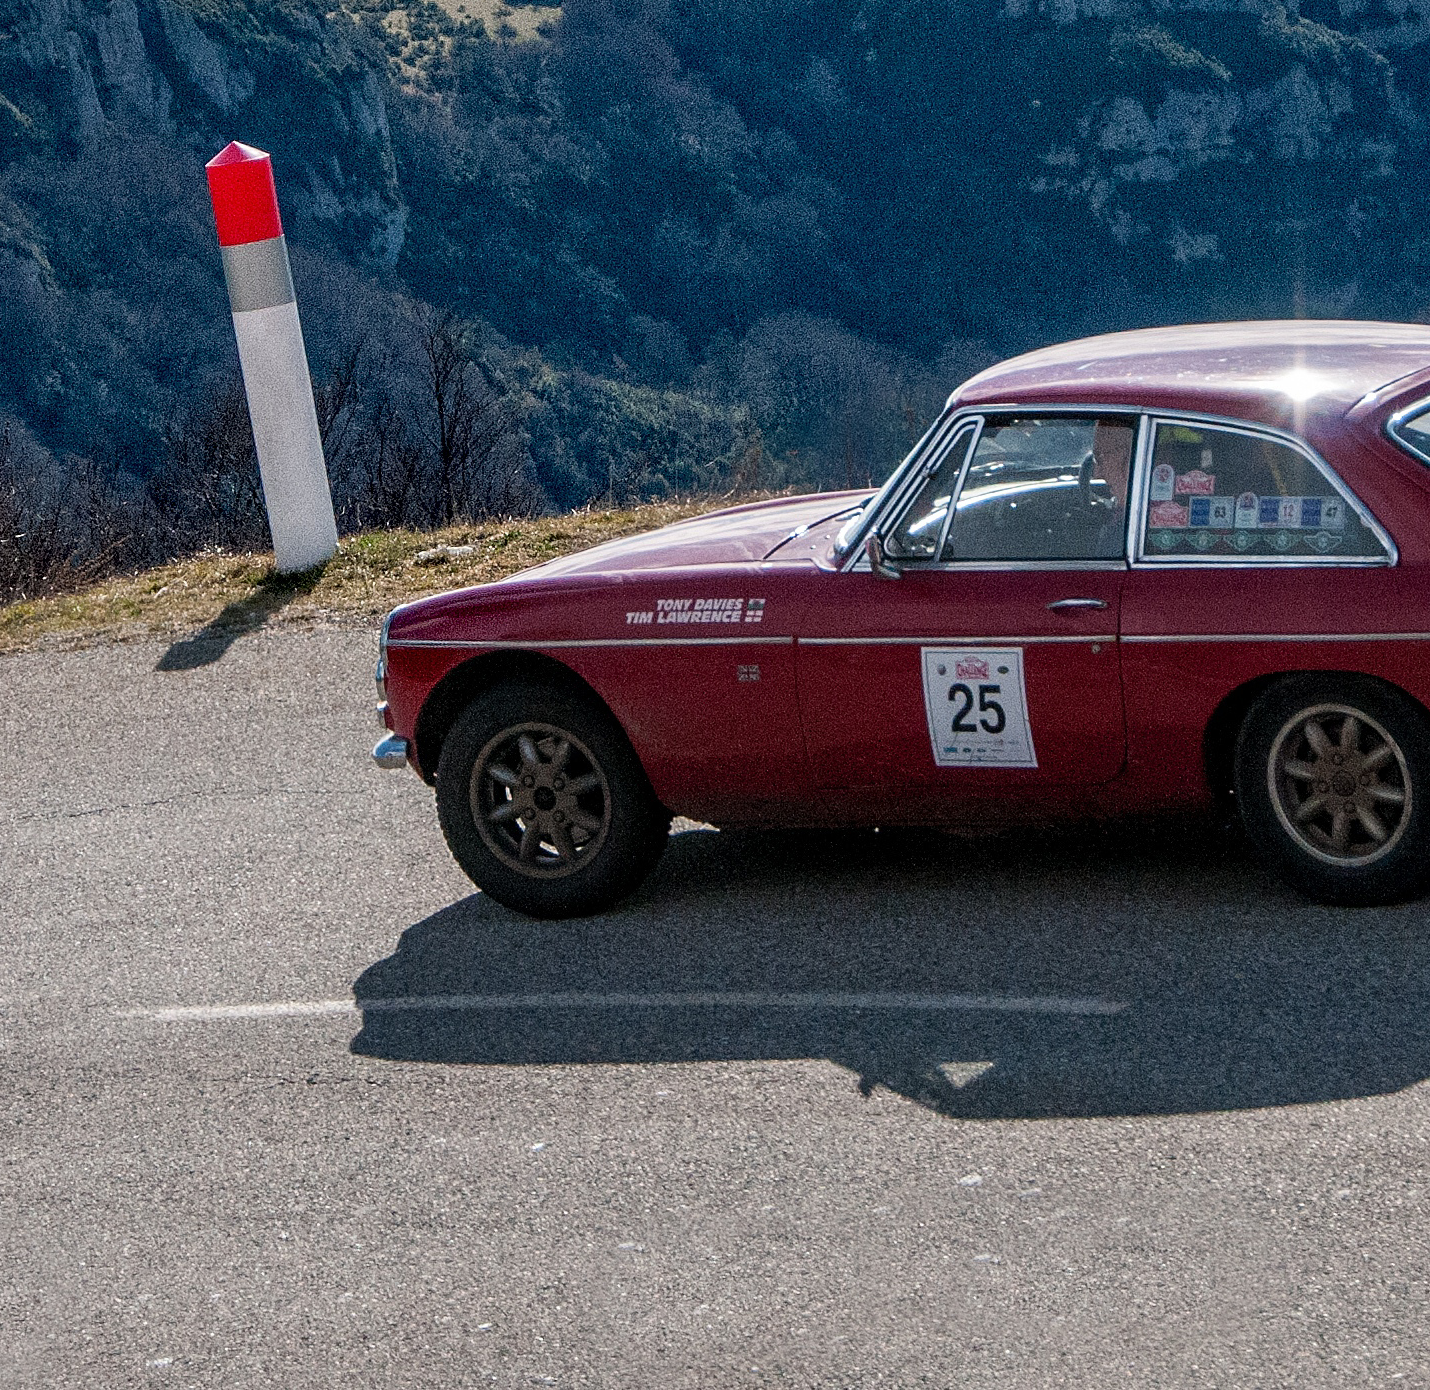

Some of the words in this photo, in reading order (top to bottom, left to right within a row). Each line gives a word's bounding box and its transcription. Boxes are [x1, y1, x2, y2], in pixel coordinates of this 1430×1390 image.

[657, 598, 693, 611] TONY
[694, 598, 744, 610] DAVIES
[626, 611, 654, 624] TIM
[657, 610, 742, 624] LAWRENCE
[948, 683, 1006, 734] 25
